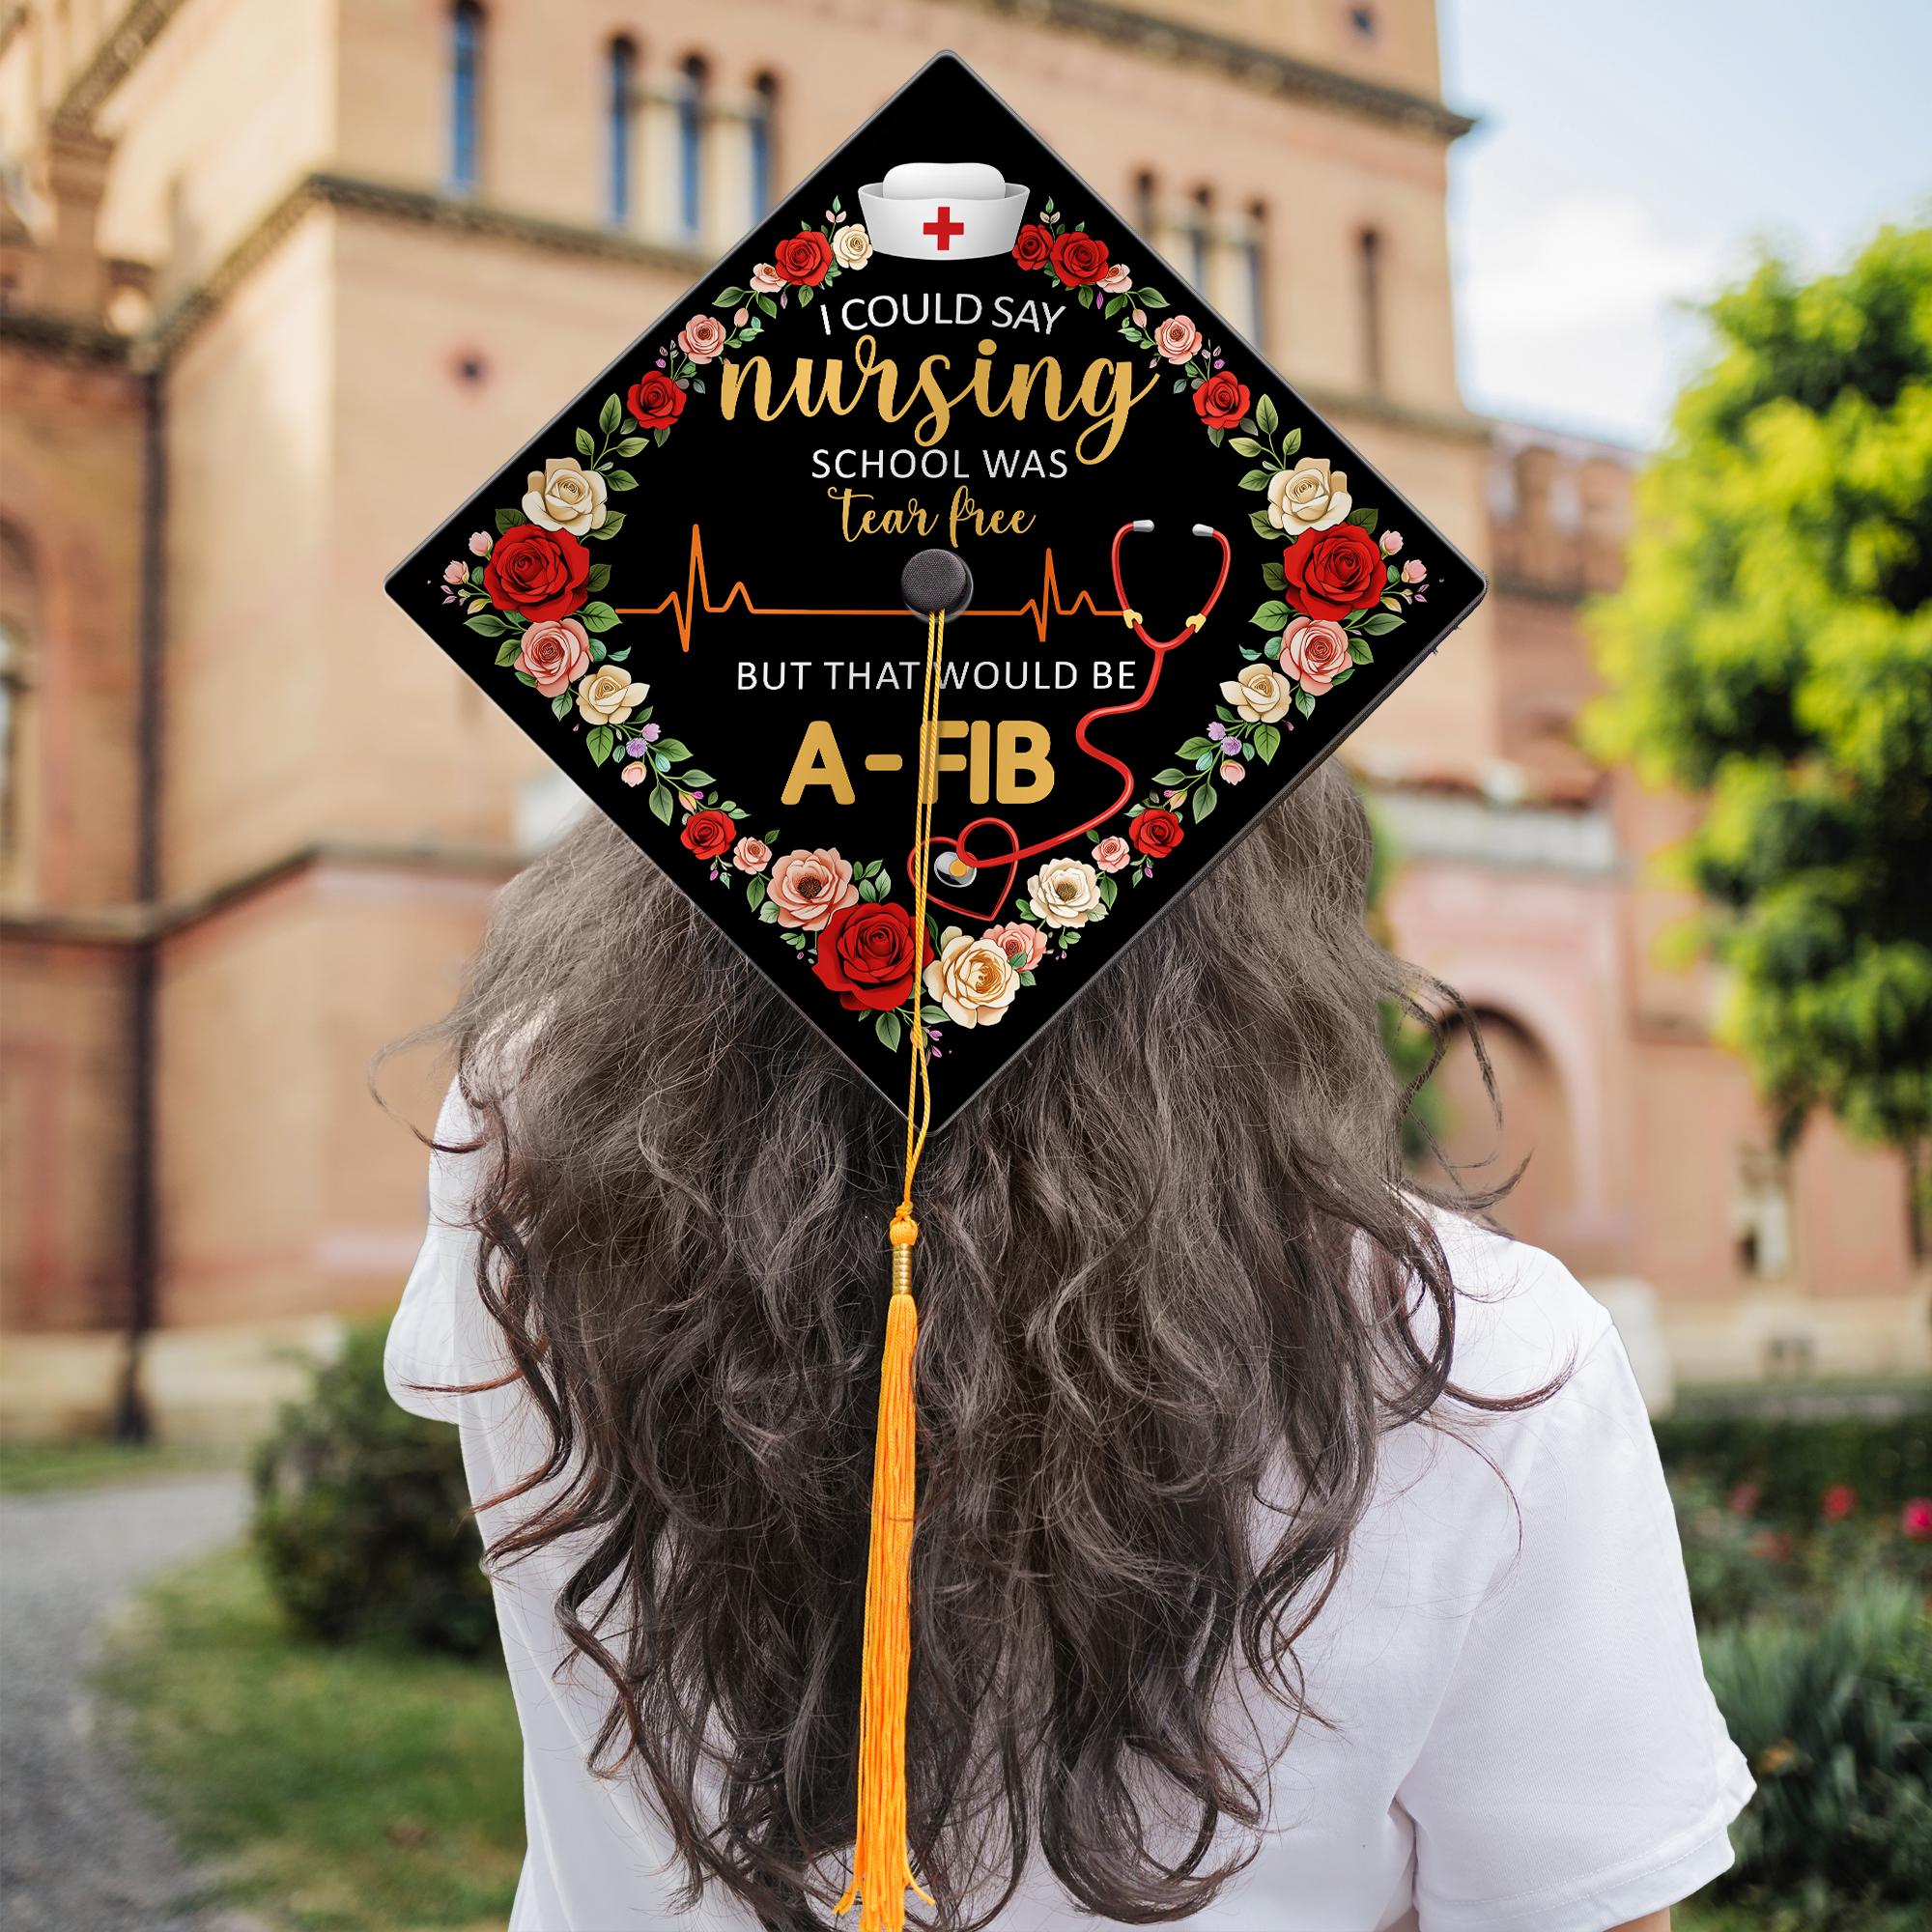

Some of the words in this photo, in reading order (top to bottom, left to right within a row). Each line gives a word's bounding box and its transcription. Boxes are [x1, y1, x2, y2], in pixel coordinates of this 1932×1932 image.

[819, 303, 832, 336] I
[841, 293, 983, 330] COULD
[991, 296, 1067, 335] SAY
[721, 334, 1161, 466] nursing
[811, 448, 970, 479] SCHOOL
[981, 448, 1068, 479] WAS
[826, 486, 940, 543] tear
[949, 485, 1037, 549] free
[737, 661, 812, 691] BUT
[823, 661, 921, 691] THAT
[932, 661, 1078, 690] WOULD
[1093, 661, 1136, 690] BE
